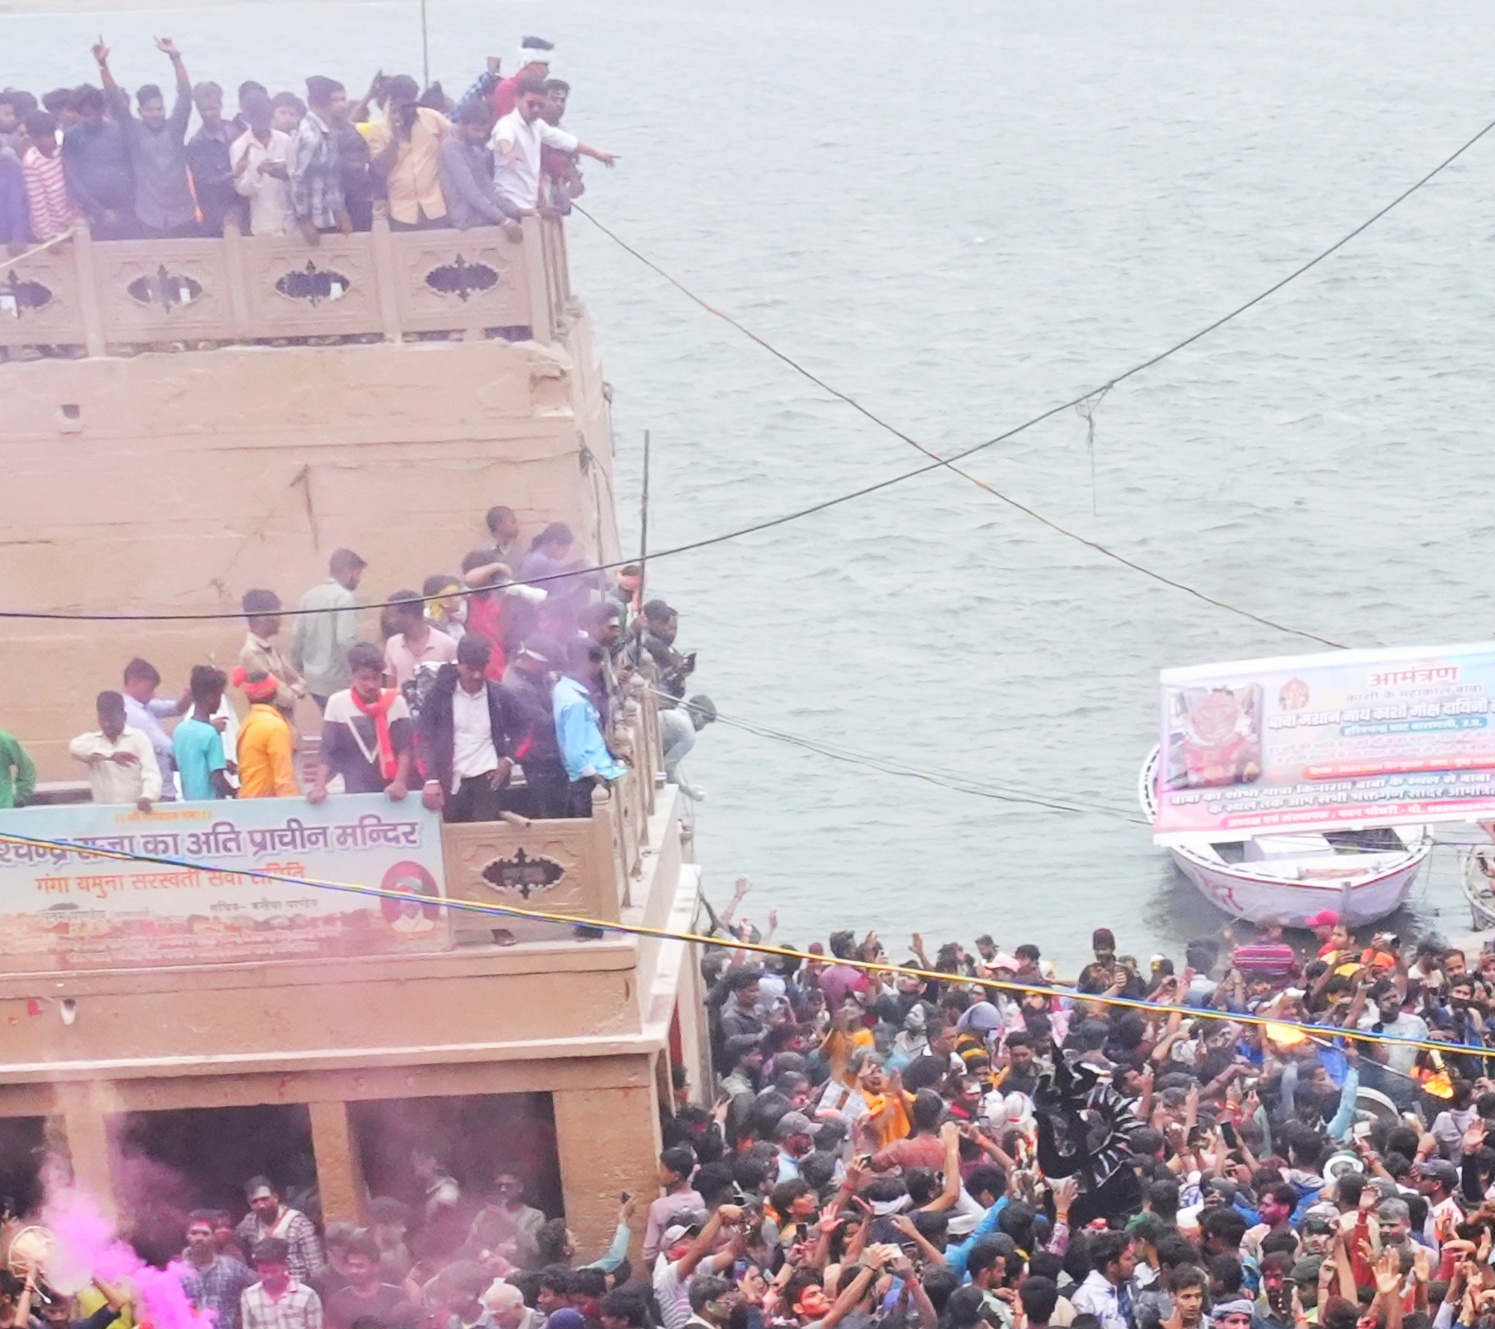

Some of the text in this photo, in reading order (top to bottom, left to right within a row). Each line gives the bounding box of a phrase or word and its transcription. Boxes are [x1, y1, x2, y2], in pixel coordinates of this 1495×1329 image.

[1368, 665, 1460, 688] आमंत्रण
[1346, 689, 1379, 702] काशी
[1400, 686, 1451, 699] महाकाल
[140, 833, 179, 856] का
[186, 821, 241, 855] अति
[247, 818, 328, 856] प्राचीन
[335, 813, 419, 848] मन्दिर
[35, 873, 69, 894] गंगा
[75, 874, 124, 898] यमुना
[129, 869, 201, 890] सरस्वती
